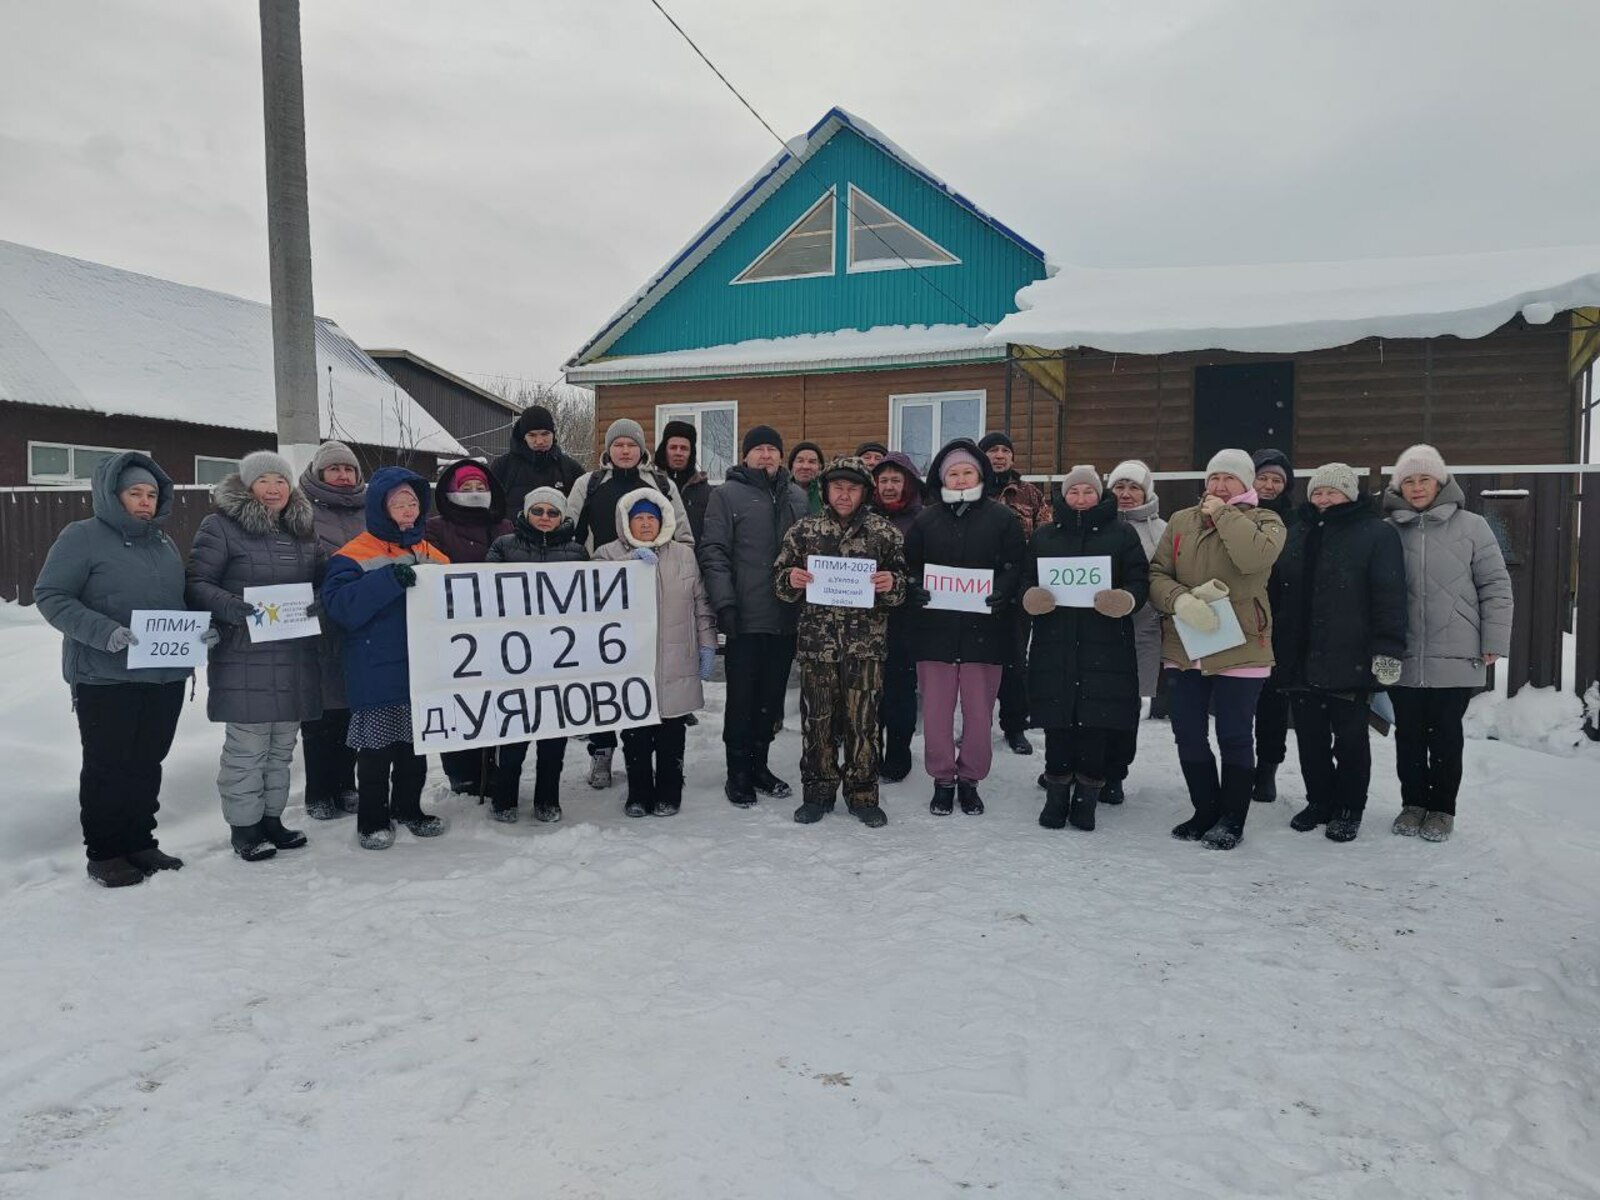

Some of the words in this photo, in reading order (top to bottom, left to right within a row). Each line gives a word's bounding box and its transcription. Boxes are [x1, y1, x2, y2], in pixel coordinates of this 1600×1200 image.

[813, 559, 876, 573] ППМИ-2026
[925, 574, 991, 594] ППМИ
[1049, 567, 1101, 586] 2026
[444, 567, 629, 619] ППМИ
[146, 618, 202, 633] ППМИ-
[150, 642, 190, 656] 2026
[450, 622, 627, 678] 2026
